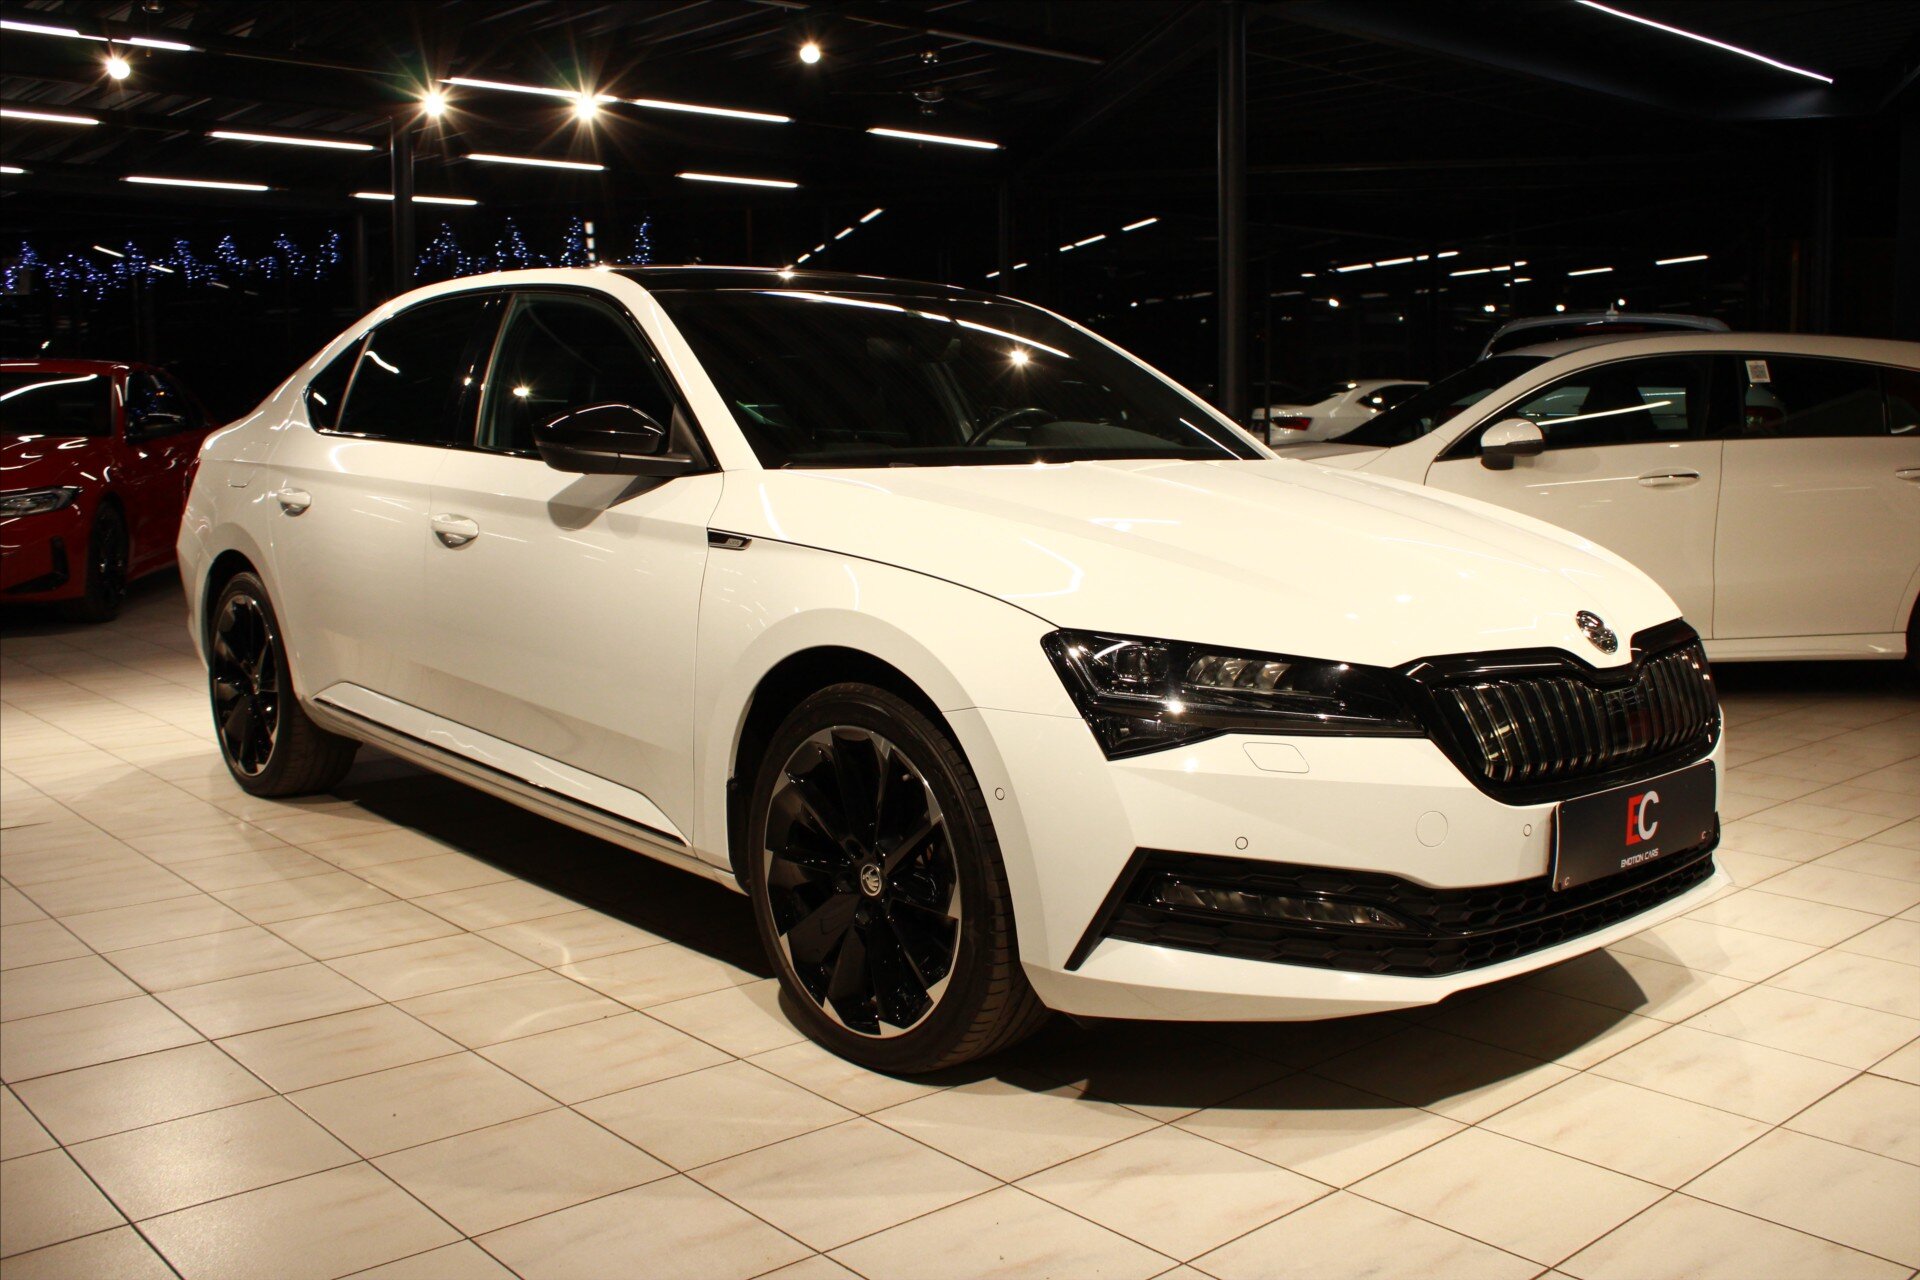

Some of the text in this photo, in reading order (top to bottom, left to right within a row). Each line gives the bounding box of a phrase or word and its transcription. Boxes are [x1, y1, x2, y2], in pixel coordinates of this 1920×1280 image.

[1626, 791, 1660, 846] EC
[1620, 848, 1659, 868] EMOTION CARS
